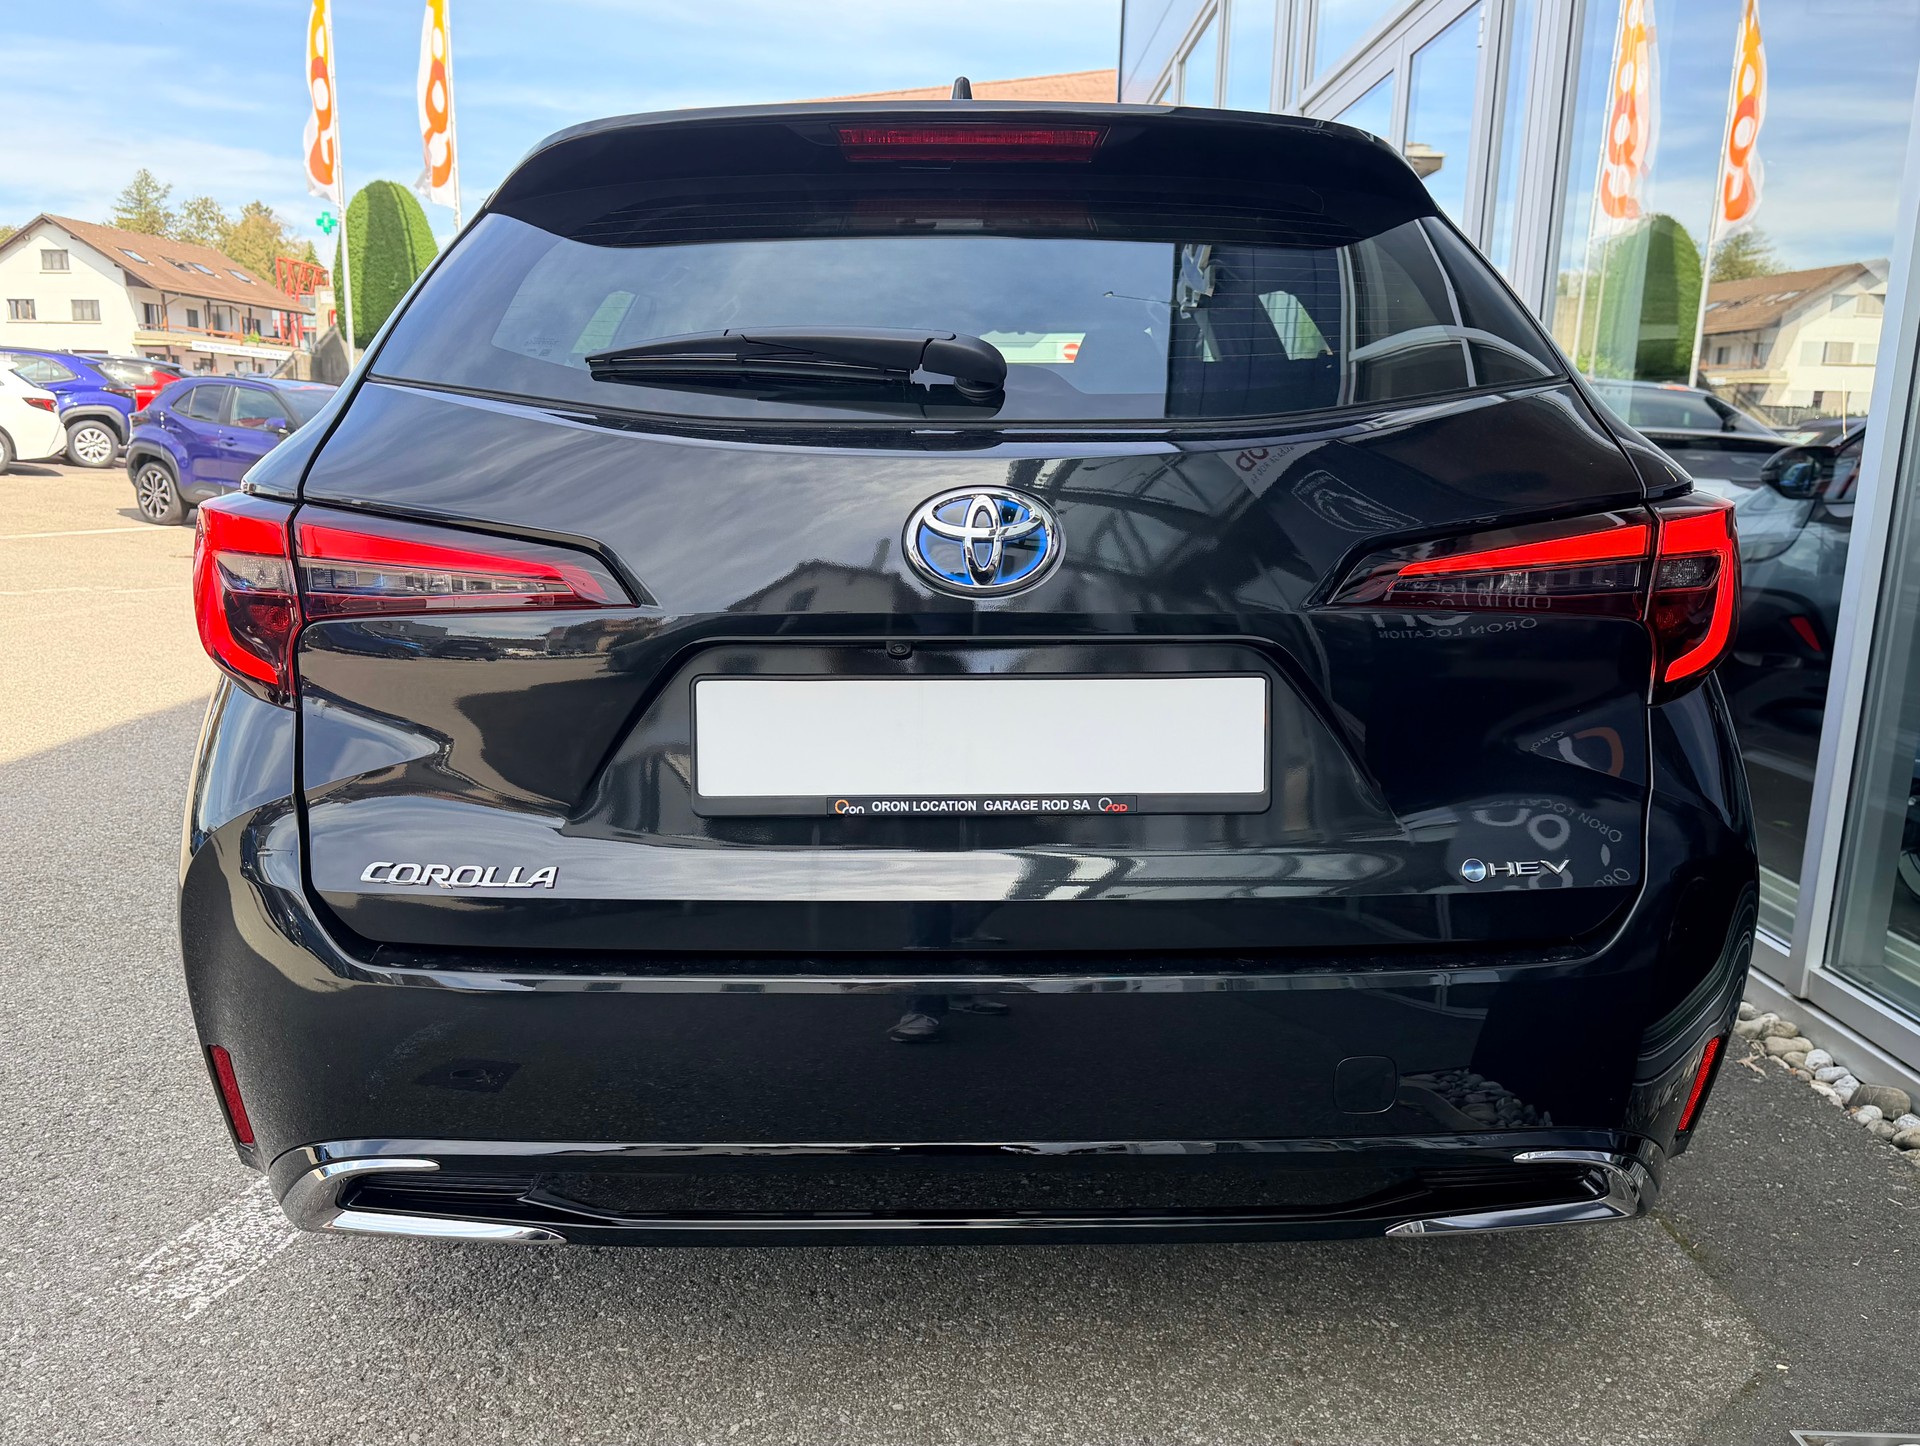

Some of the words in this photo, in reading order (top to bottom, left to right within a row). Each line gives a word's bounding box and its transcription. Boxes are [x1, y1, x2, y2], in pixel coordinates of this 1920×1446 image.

[871, 801, 909, 812] ORON
[912, 800, 977, 812] LOCATION
[983, 800, 1039, 811] GARAGE
[1041, 799, 1069, 811] ROD
[1072, 799, 1091, 810] SA
[360, 861, 559, 889] COROLLA
[1487, 859, 1571, 877] HEV
